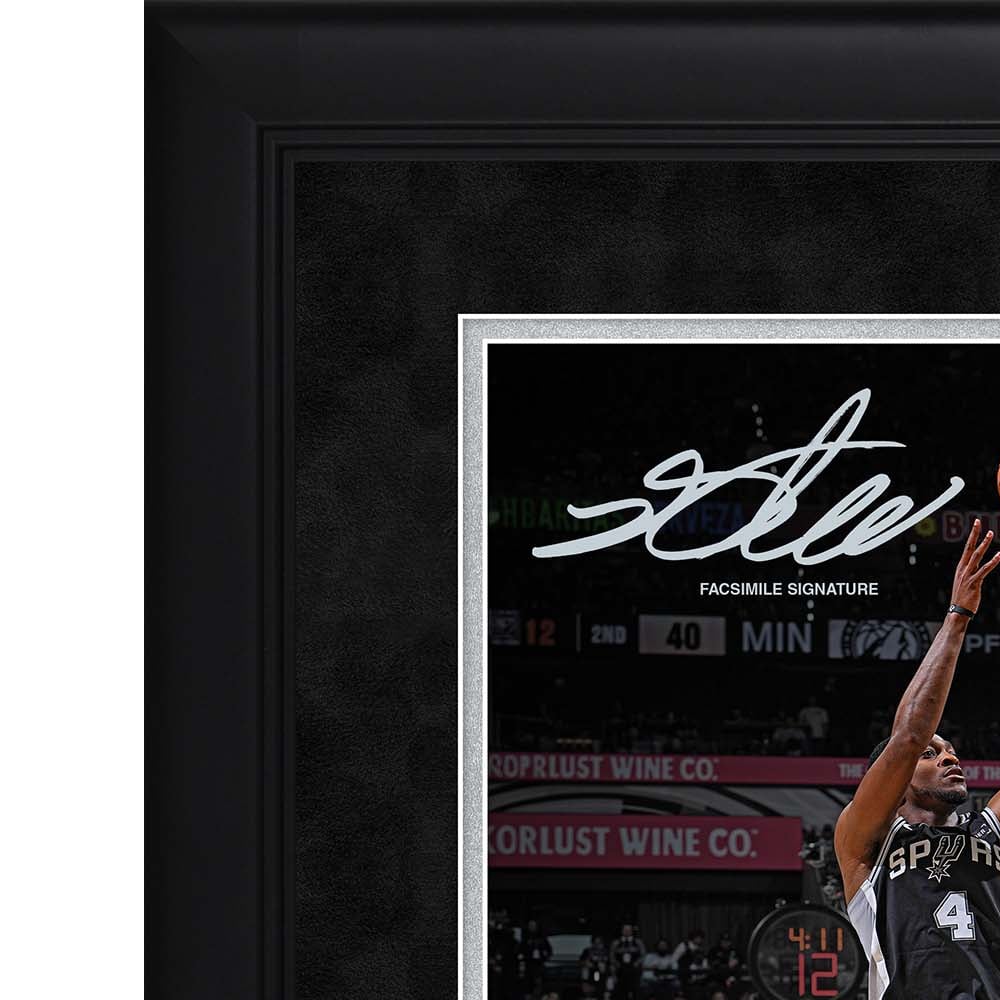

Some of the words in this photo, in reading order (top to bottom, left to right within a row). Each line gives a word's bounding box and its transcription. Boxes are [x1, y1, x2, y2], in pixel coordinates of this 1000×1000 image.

[526, 616, 558, 647] 12
[591, 624, 628, 645] 2ND
[666, 621, 701, 650] 40
[741, 620, 813, 655] MIN
[609, 755, 673, 779] WINE
[619, 826, 700, 857] WINE
[933, 890, 976, 942] 4
[787, 927, 844, 951] 4:11
[796, 952, 839, 997] 12
